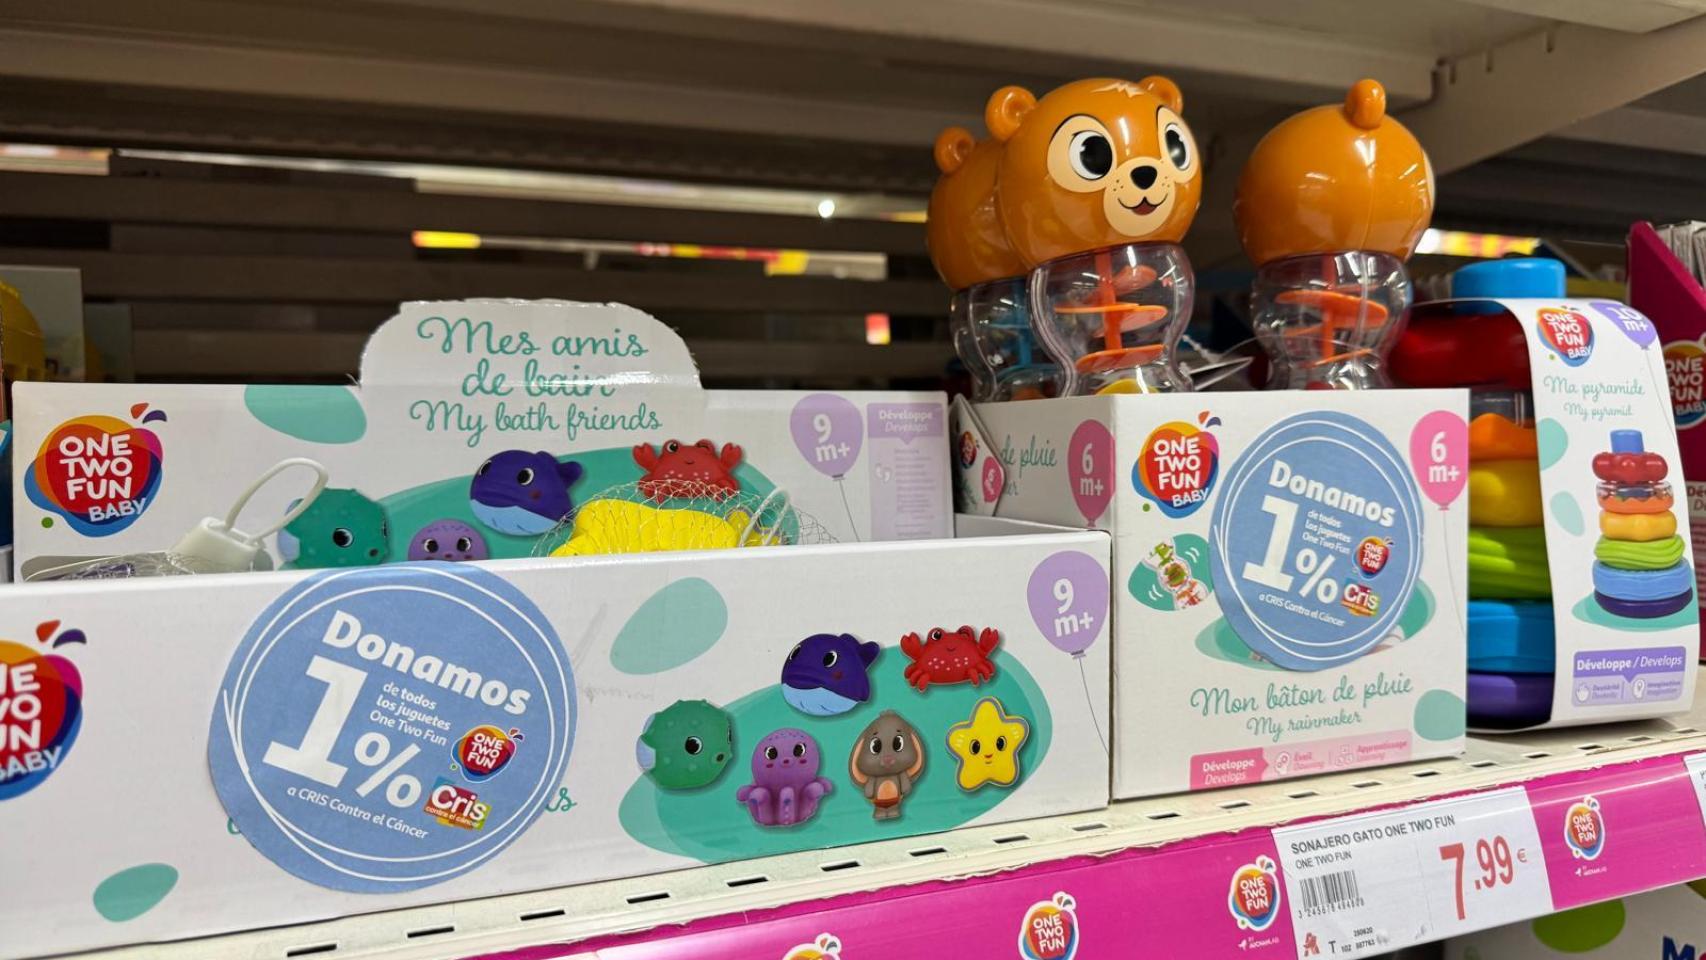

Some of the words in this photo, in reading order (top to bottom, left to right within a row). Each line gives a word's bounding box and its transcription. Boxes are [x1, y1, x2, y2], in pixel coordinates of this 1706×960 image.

[1543, 313, 1577, 324] ONE
[1549, 321, 1581, 333] TWO
[1624, 318, 1648, 332] m+
[417, 316, 541, 355] Mes
[551, 328, 648, 356] amis
[1557, 332, 1584, 346] FUN
[1567, 345, 1593, 359] BABY
[461, 358, 513, 397] de
[1543, 376, 1578, 394] Ma
[1582, 379, 1646, 402] pyramide
[878, 409, 933, 423] Développe
[1564, 402, 1588, 418] My
[1591, 404, 1635, 421] pyramid
[409, 400, 488, 447] My
[495, 401, 560, 432] bath
[566, 402, 663, 441] friends
[812, 413, 833, 443] 9
[59, 433, 132, 456] ONE
[815, 443, 850, 463] m+
[1153, 436, 1201, 456] ONE
[1430, 431, 1447, 463] 6
[1000, 434, 1015, 465] de
[1019, 435, 1057, 478] pluie
[1081, 442, 1094, 475] 6
[1153, 455, 1201, 472] TWO
[59, 457, 133, 478] TWO
[1428, 463, 1461, 483] m+
[67, 476, 132, 500] FUN
[1079, 477, 1104, 497] m+
[1158, 470, 1200, 490] FUN
[1172, 487, 1209, 507] BABY
[1269, 459, 1396, 528] Donamos
[88, 497, 147, 522] BABY
[1307, 510, 1318, 519] de
[1319, 513, 1342, 528] todos
[1302, 531, 1319, 544] One
[1319, 537, 1336, 549] Two
[1335, 542, 1351, 554] Fun
[1317, 523, 1351, 543] juguetes
[1242, 494, 1339, 604] 1%
[1363, 550, 1382, 562] TWO
[1364, 541, 1384, 555] ONE
[1361, 557, 1381, 570] FUN
[1053, 578, 1075, 614] 9
[1344, 583, 1378, 610] Cris
[1258, 593, 1266, 601] a
[1266, 594, 1285, 607] CRIS
[1284, 600, 1311, 616] Contra
[1310, 608, 1319, 618] el
[1319, 610, 1346, 627] Cáncer
[1054, 611, 1094, 637] m+
[321, 609, 531, 716] Donamos
[1576, 657, 1632, 672] Développe
[1640, 655, 1683, 669] Develops
[383, 682, 400, 698] de
[401, 688, 437, 710] todos
[1190, 687, 1259, 716] Mon
[1266, 682, 1326, 710] bâton
[1333, 675, 1357, 702] de
[1363, 672, 1414, 709] pluie
[376, 695, 397, 711] los
[396, 703, 451, 731] juguetes
[262, 654, 422, 808] 1%
[370, 710, 396, 728] One
[398, 718, 423, 737] Two
[424, 729, 448, 747] Fun
[1246, 716, 1284, 742] My
[1288, 708, 1362, 732] rainmaker
[471, 742, 500, 759] TWO
[474, 733, 505, 751] ONE
[467, 752, 497, 769] FUN
[1203, 758, 1255, 773] Développe
[1205, 771, 1246, 786] Develops
[287, 786, 296, 796] a
[298, 787, 329, 806] CRIS
[329, 798, 371, 822] Contra
[372, 813, 385, 825] el
[386, 816, 429, 839] Cáncer
[431, 785, 487, 821] Cris
[1573, 813, 1593, 824] ONE
[1575, 822, 1595, 833] TWO
[1290, 833, 1351, 855] SONAJERO
[1352, 827, 1383, 843] GATO
[1384, 822, 1407, 837] ONE
[1408, 818, 1433, 833] TWO
[1435, 815, 1456, 829] FUN
[1578, 831, 1596, 843] FUN
[1295, 856, 1313, 870] ONE
[1315, 852, 1335, 867] TWO
[1335, 850, 1352, 863] FUN
[1240, 877, 1266, 889] ONE
[1438, 835, 1514, 921] 7.99
[1517, 848, 1528, 863] €
[1242, 887, 1267, 900] TWO
[1246, 896, 1269, 911] FUN
[1033, 914, 1063, 929] ONE
[1034, 926, 1064, 940] TWO
[1039, 935, 1066, 953] FUN
[1328, 940, 1336, 954] T
